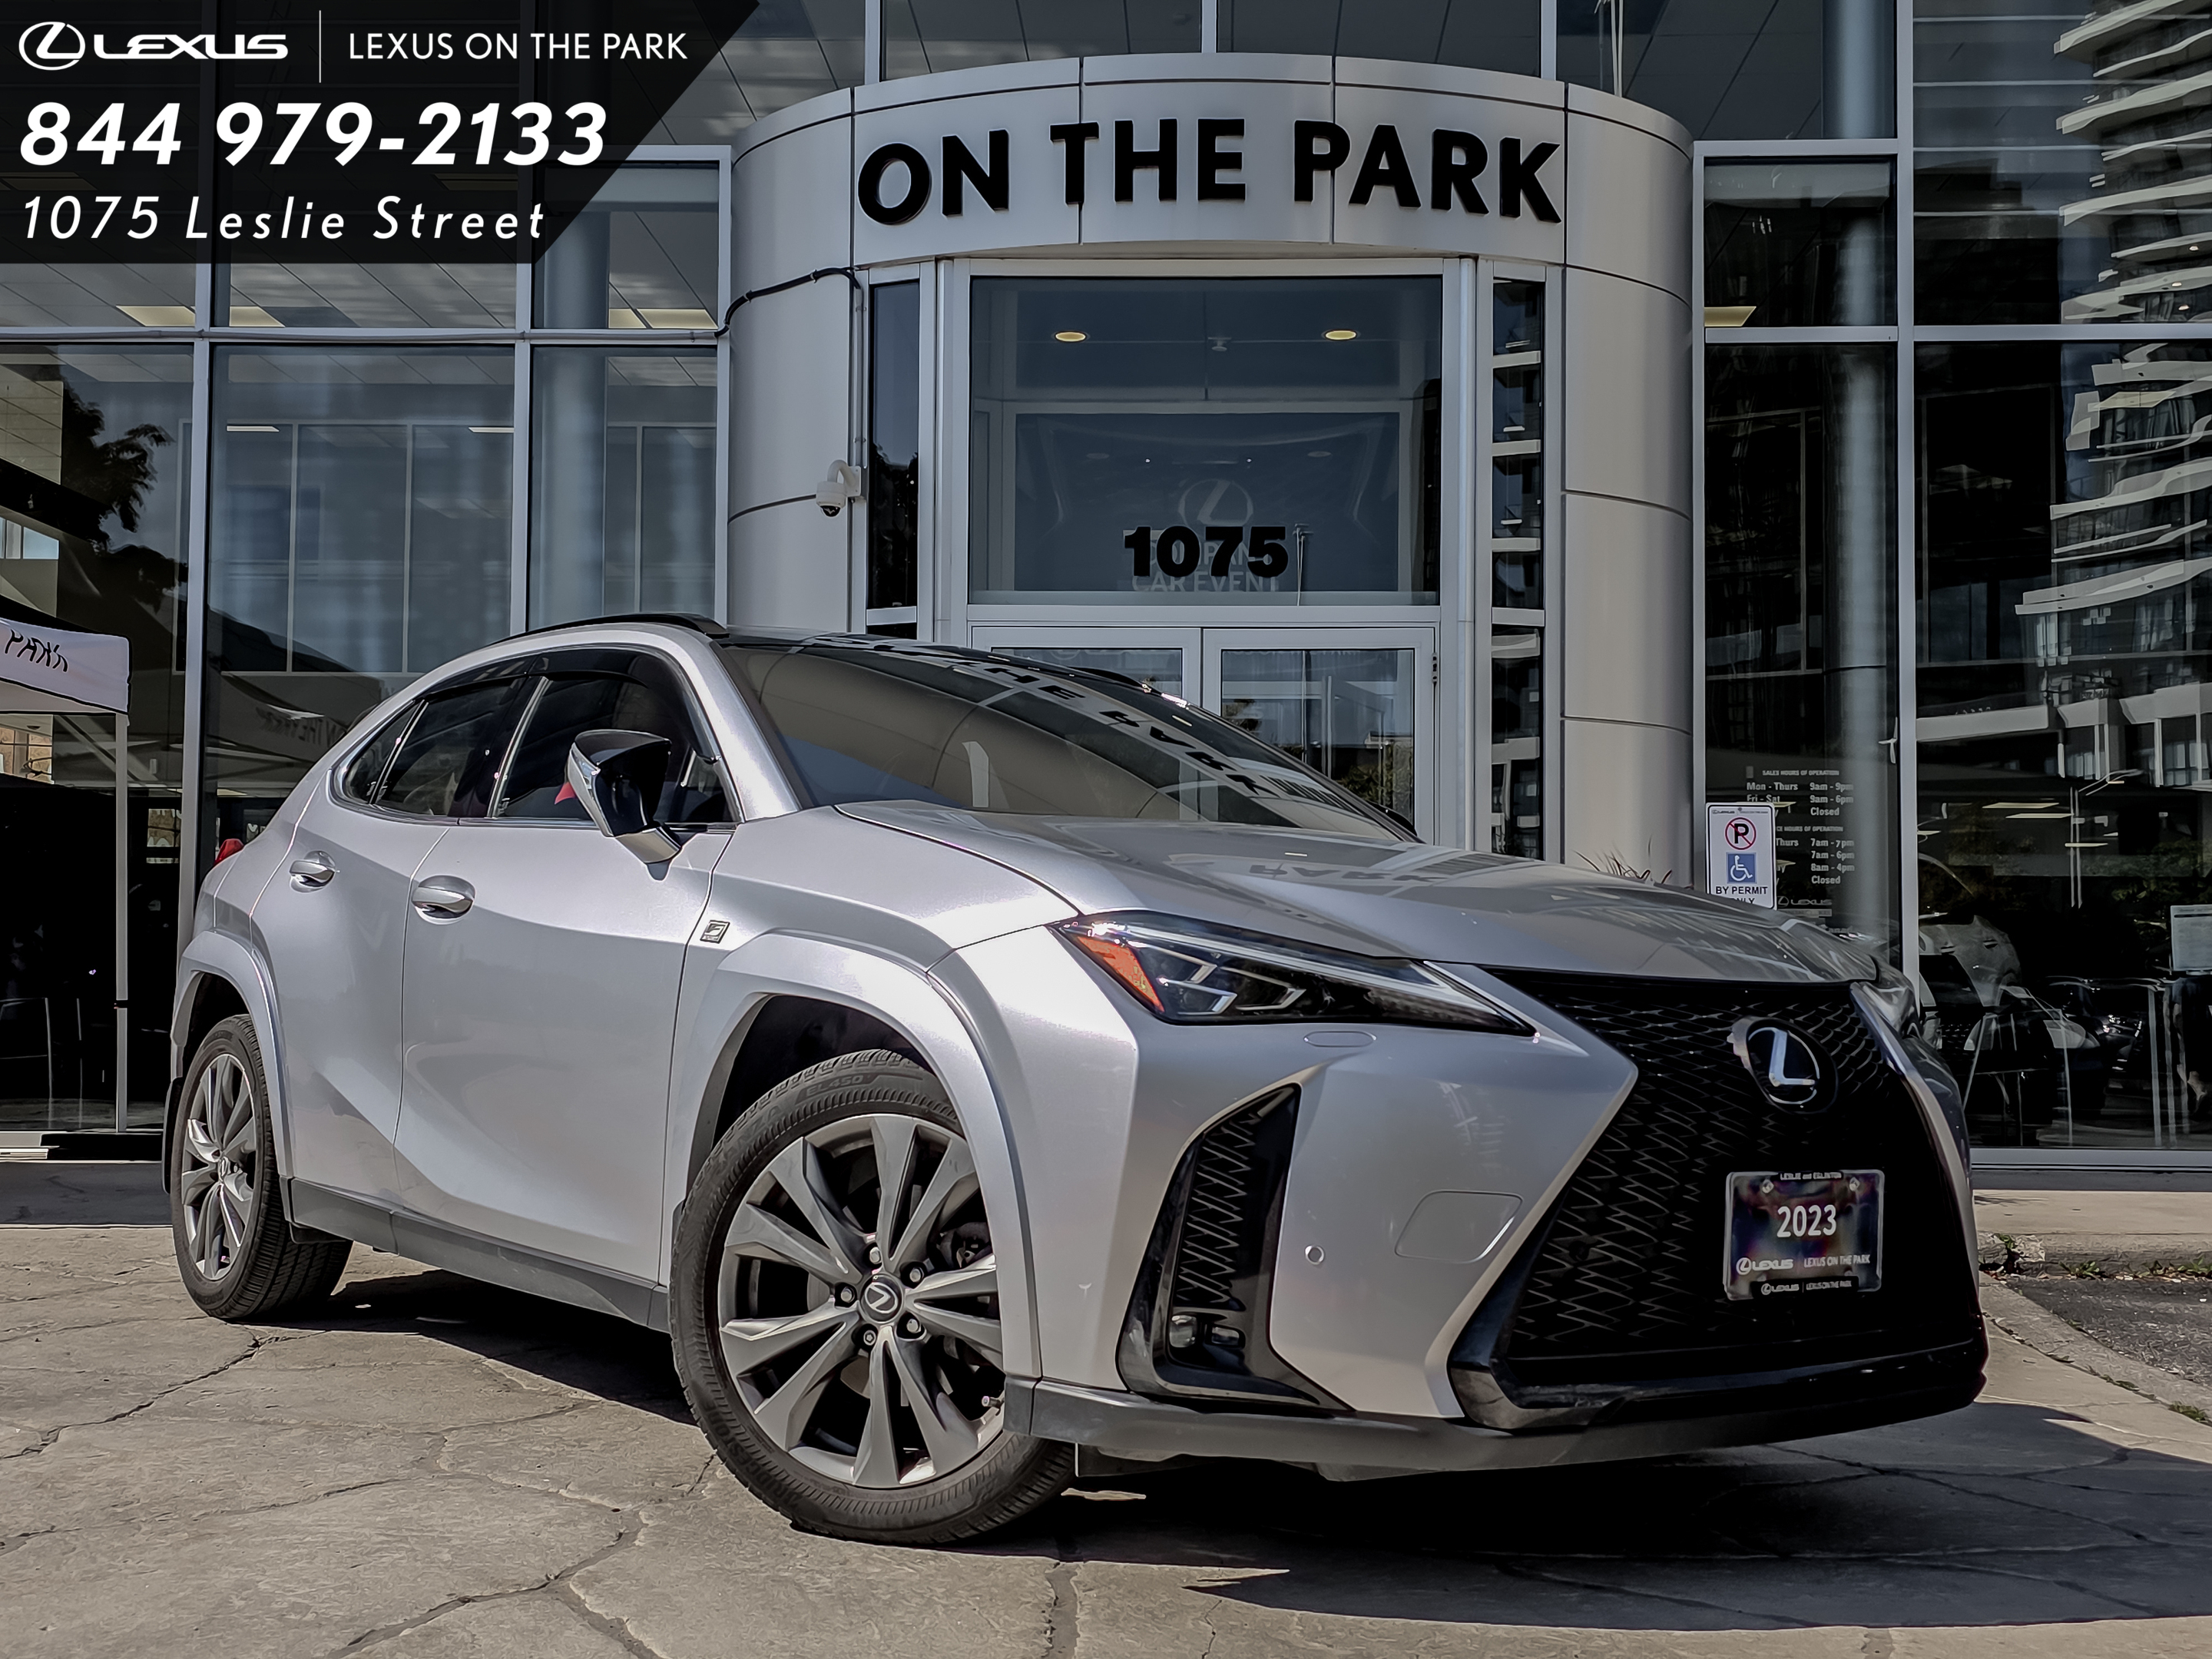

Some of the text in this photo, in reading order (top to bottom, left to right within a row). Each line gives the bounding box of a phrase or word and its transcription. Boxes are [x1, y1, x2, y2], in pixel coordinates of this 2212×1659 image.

[858, 118, 1561, 226] ON THE PARK
[1124, 525, 1289, 579] 1075
[1747, 782, 1766, 790] Mon
[1773, 782, 1798, 790] Thurs
[1810, 782, 1828, 790] 9am
[1835, 782, 1854, 793] 9pm
[1766, 794, 1780, 803] Sat
[1810, 794, 1828, 803] 9am
[1836, 794, 1854, 805] 6pm
[1810, 806, 1840, 816] Closed
[1810, 837, 1829, 846] 7am
[1836, 839, 1855, 849] 7pm
[1811, 850, 1829, 859] 7am
[1836, 850, 1855, 861] 6pm
[1810, 863, 1830, 871] 8am
[1836, 863, 1855, 873] 4pm
[1811, 876, 1841, 884] Closed
[1715, 886, 1768, 895] BY PERMIT
[1777, 1204, 1836, 1237] 2023
[1752, 1259, 1794, 1271] LEXUS
[1804, 1254, 1870, 1267] LEXUS ON THE PARK
